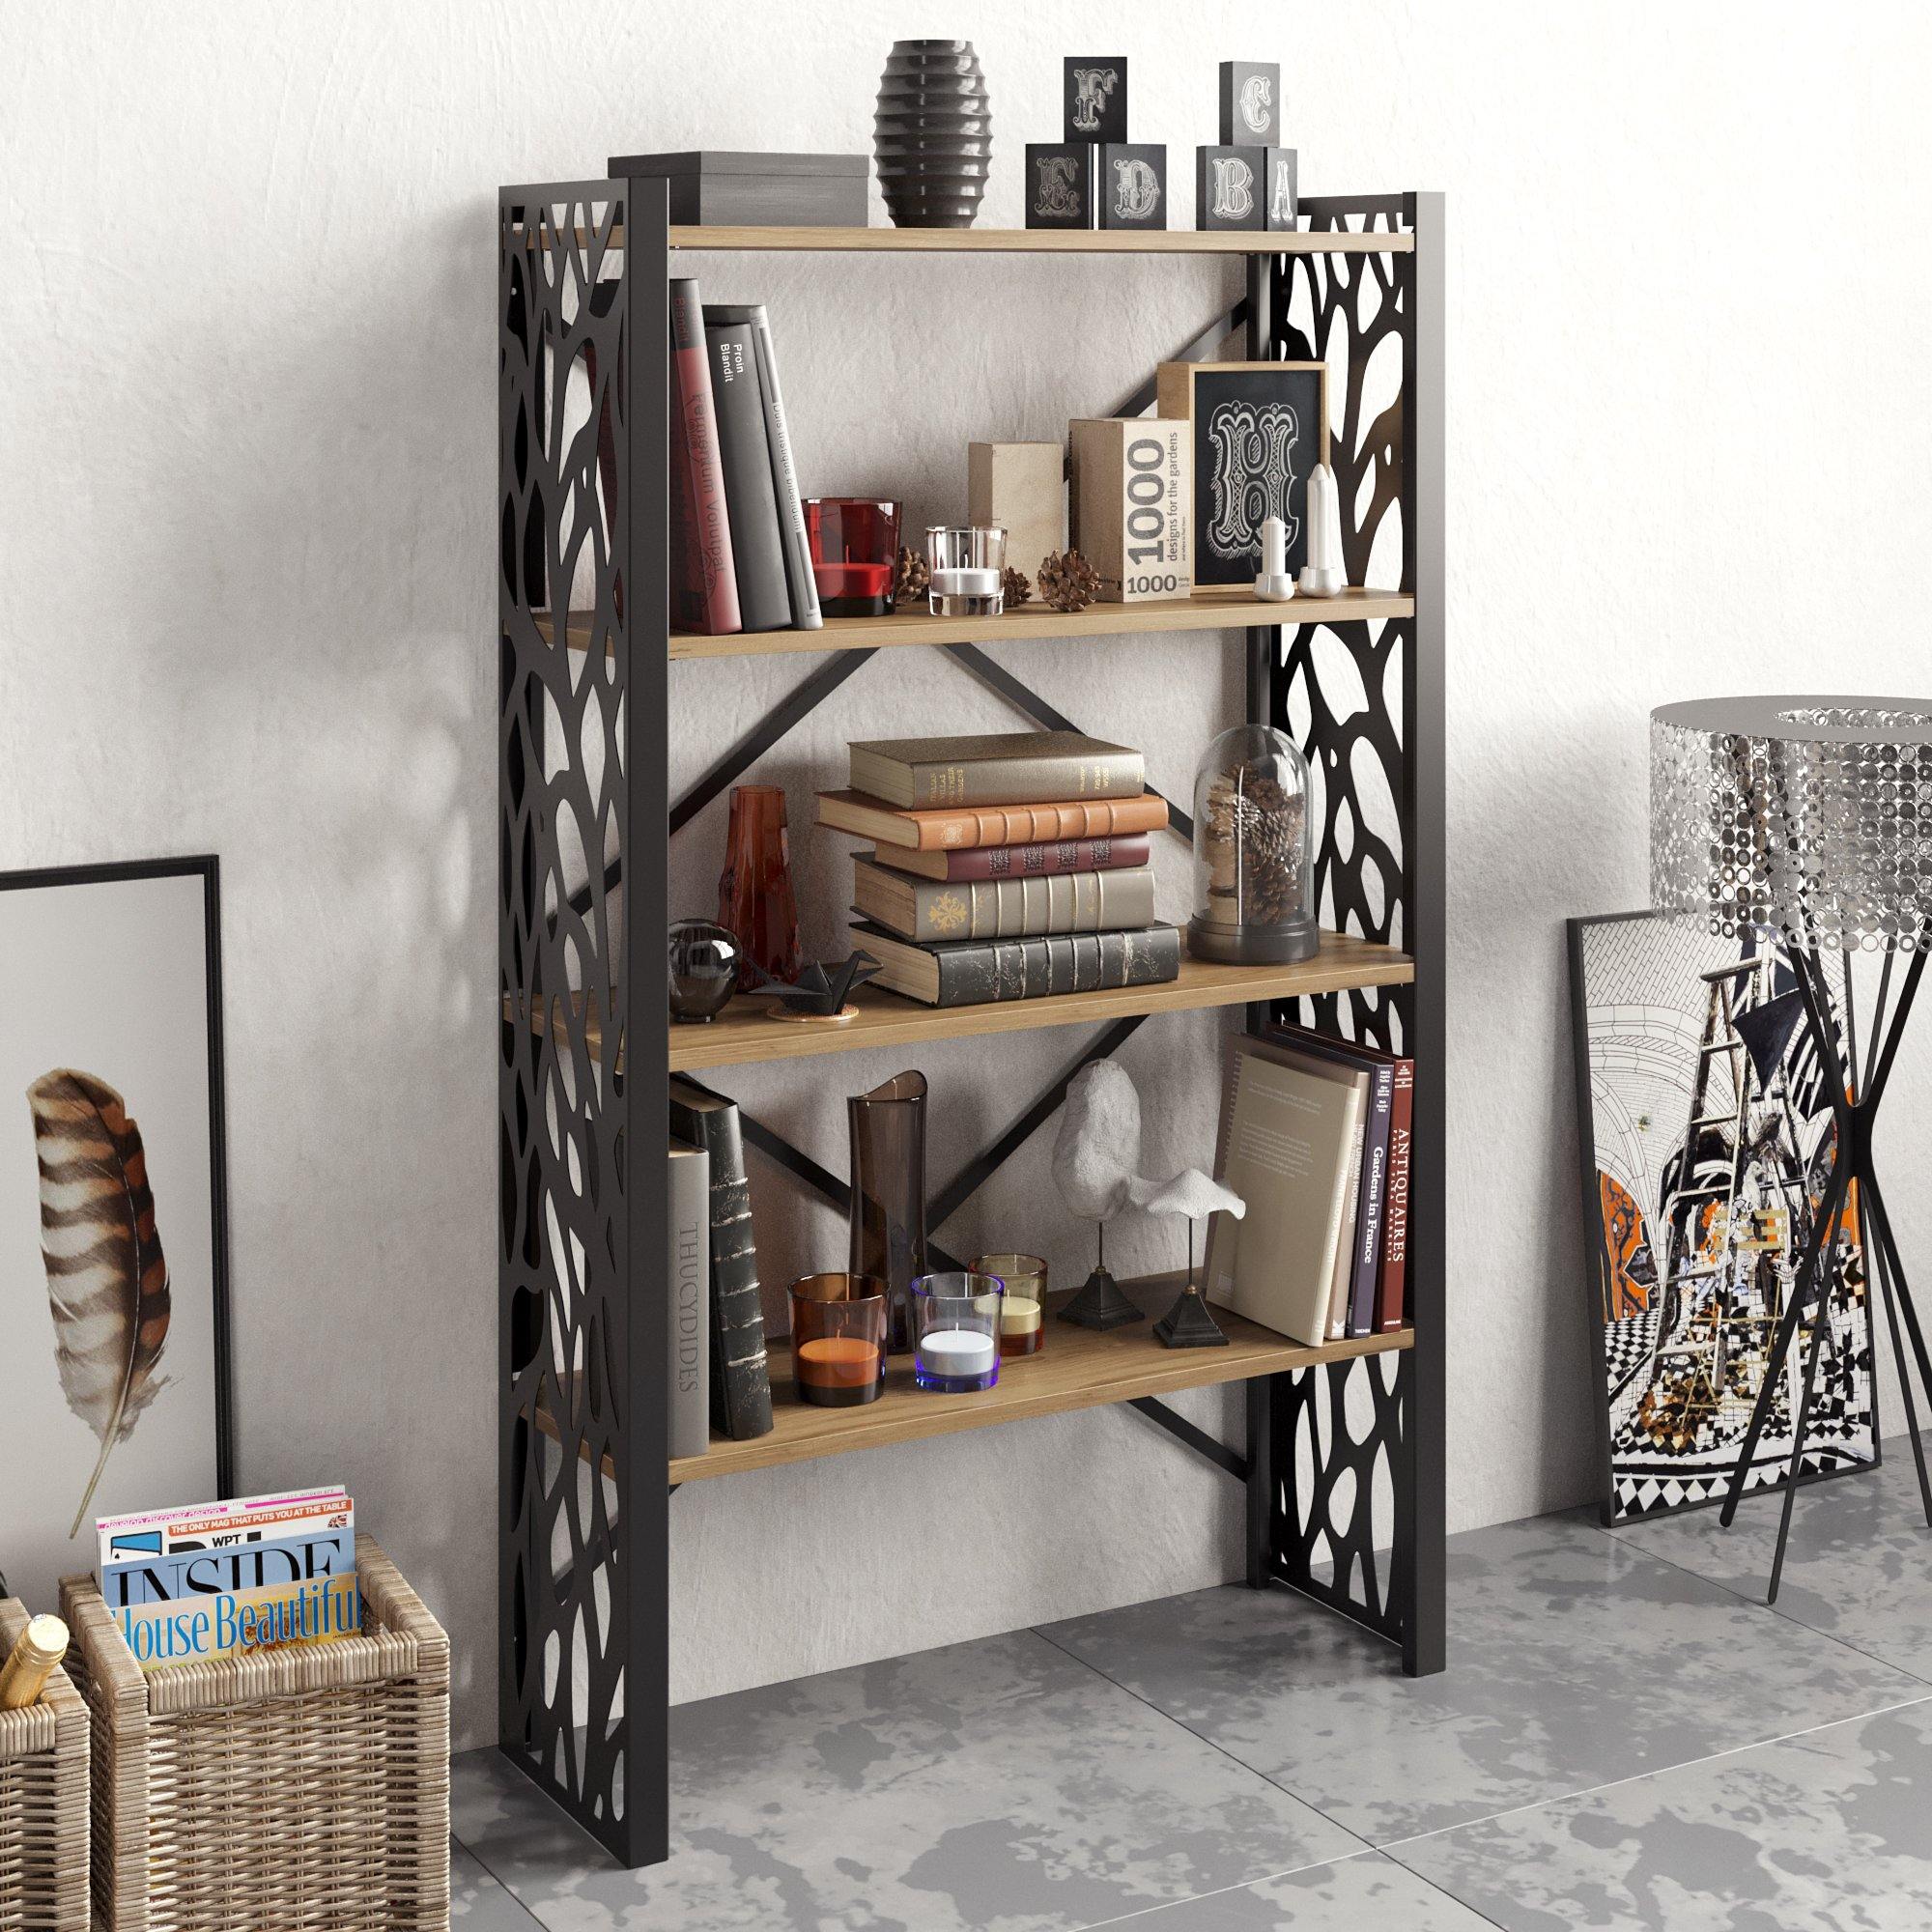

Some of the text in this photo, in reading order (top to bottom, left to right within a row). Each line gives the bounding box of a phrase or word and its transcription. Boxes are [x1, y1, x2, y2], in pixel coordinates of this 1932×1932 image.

[1072, 68, 1120, 131] F
[1240, 75, 1271, 133] C
[1035, 156, 1080, 218] E
[1114, 159, 1159, 220] D
[1211, 157, 1254, 220] B
[1270, 160, 1293, 224] A
[720, 343, 734, 383] Blandit
[733, 344, 744, 374] Proin
[1126, 439, 1165, 566] 1000
[1167, 432, 1179, 562] designs for the gardens
[1127, 575, 1178, 594] 1000
[1353, 1147, 1362, 1180] URBAN
[1349, 1181, 1359, 1224] HOUSING
[1364, 1146, 1384, 1264] Gardens in France
[1393, 1128, 1409, 1263] ANTIQUAIRES
[679, 1221, 698, 1393] THUCYDIDES
[172, 1500, 348, 1534] THE ONLY MAG THAT PUTS YOU AT THE TABLE
[212, 1534, 242, 1548] WPT
[110, 1539, 341, 1606] INSIDE
[215, 1576, 362, 1650] Beautiful
